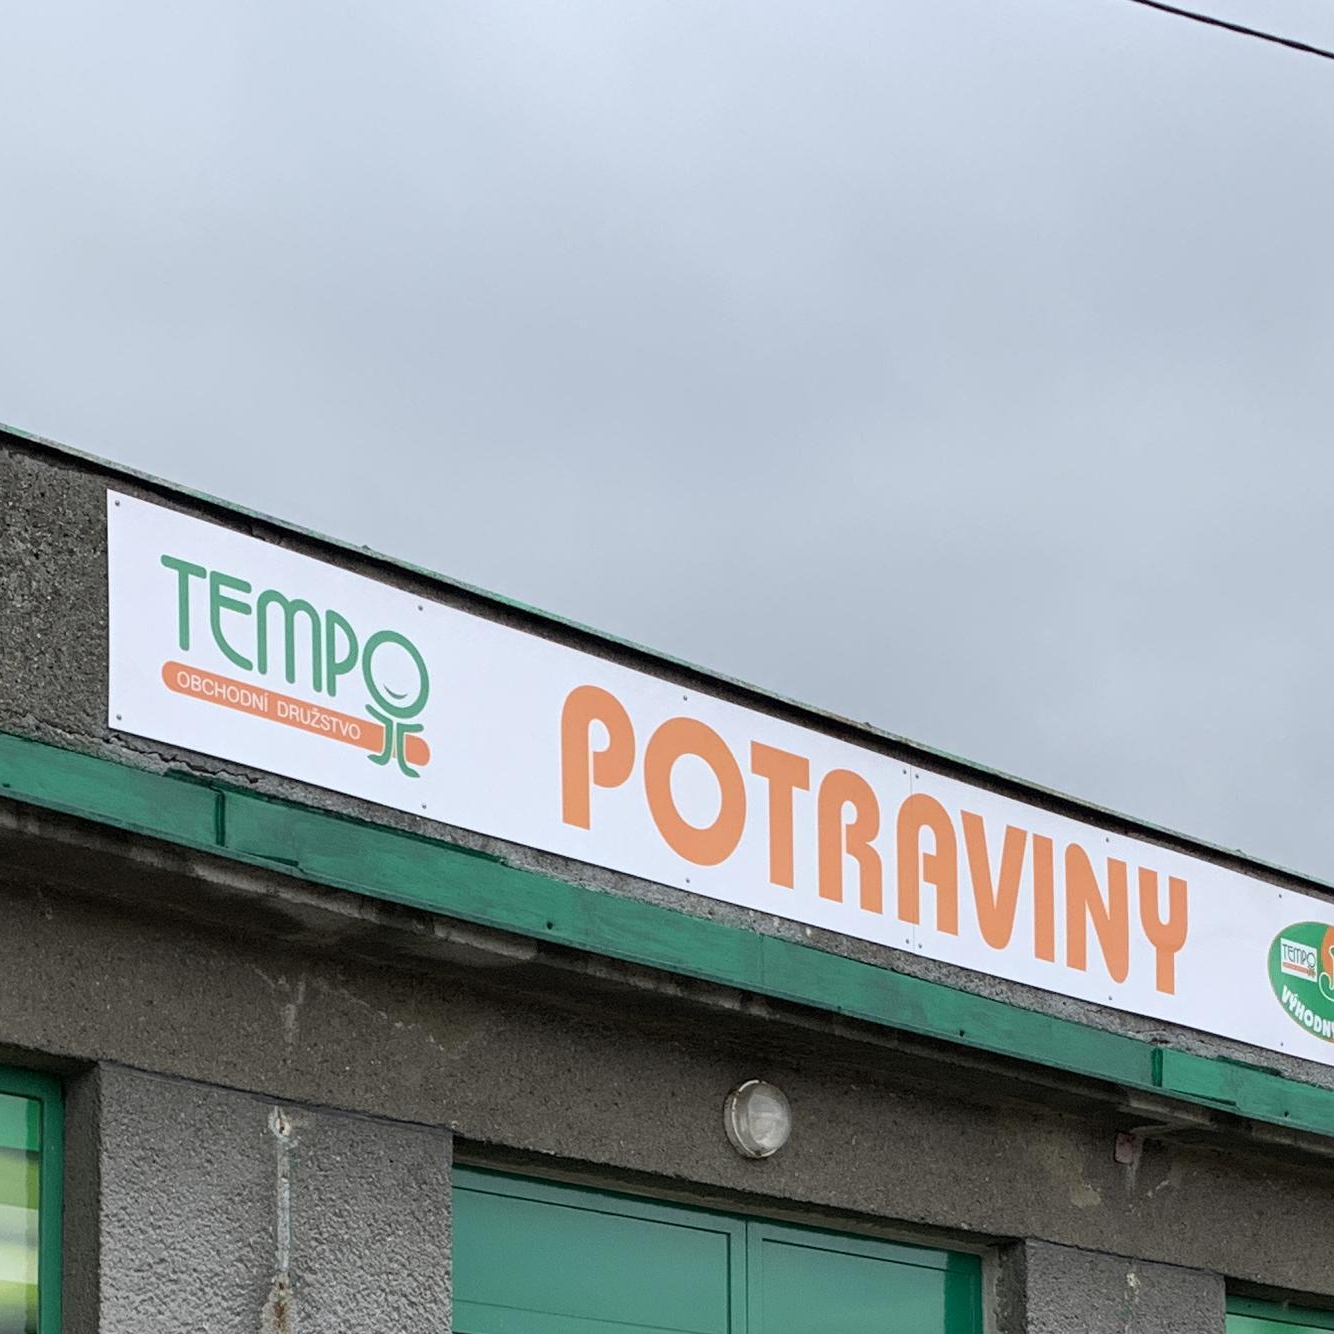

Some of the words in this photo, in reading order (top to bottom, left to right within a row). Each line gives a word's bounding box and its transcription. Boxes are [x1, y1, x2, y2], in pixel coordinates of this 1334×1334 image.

[161, 554, 430, 719] TEMPO
[177, 671, 269, 712] OBCHODNÍ
[277, 700, 361, 740] DRUŽSTVO
[560, 684, 1188, 995] POTRAVINY
[1282, 943, 1316, 970] TEMPO
